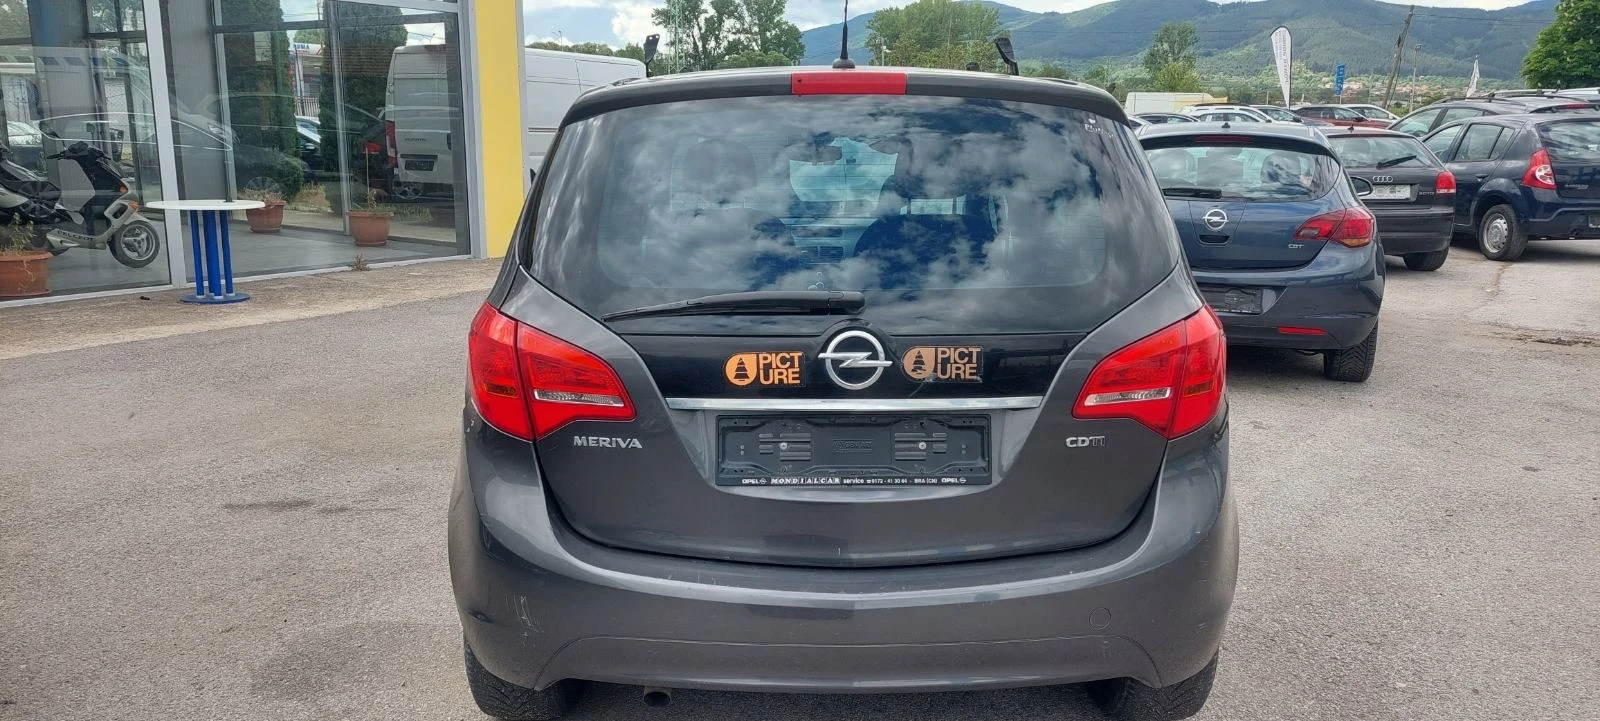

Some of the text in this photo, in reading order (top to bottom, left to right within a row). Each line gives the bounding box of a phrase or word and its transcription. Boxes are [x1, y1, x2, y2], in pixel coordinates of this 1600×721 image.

[759, 352, 803, 369] PICT
[938, 347, 981, 364] PICT
[760, 368, 801, 385] URE
[937, 363, 978, 379] URE
[573, 436, 643, 449] MERIVA
[1066, 436, 1106, 447] CDTI
[771, 477, 841, 485] MONDIALCAR
[843, 477, 865, 485] service
